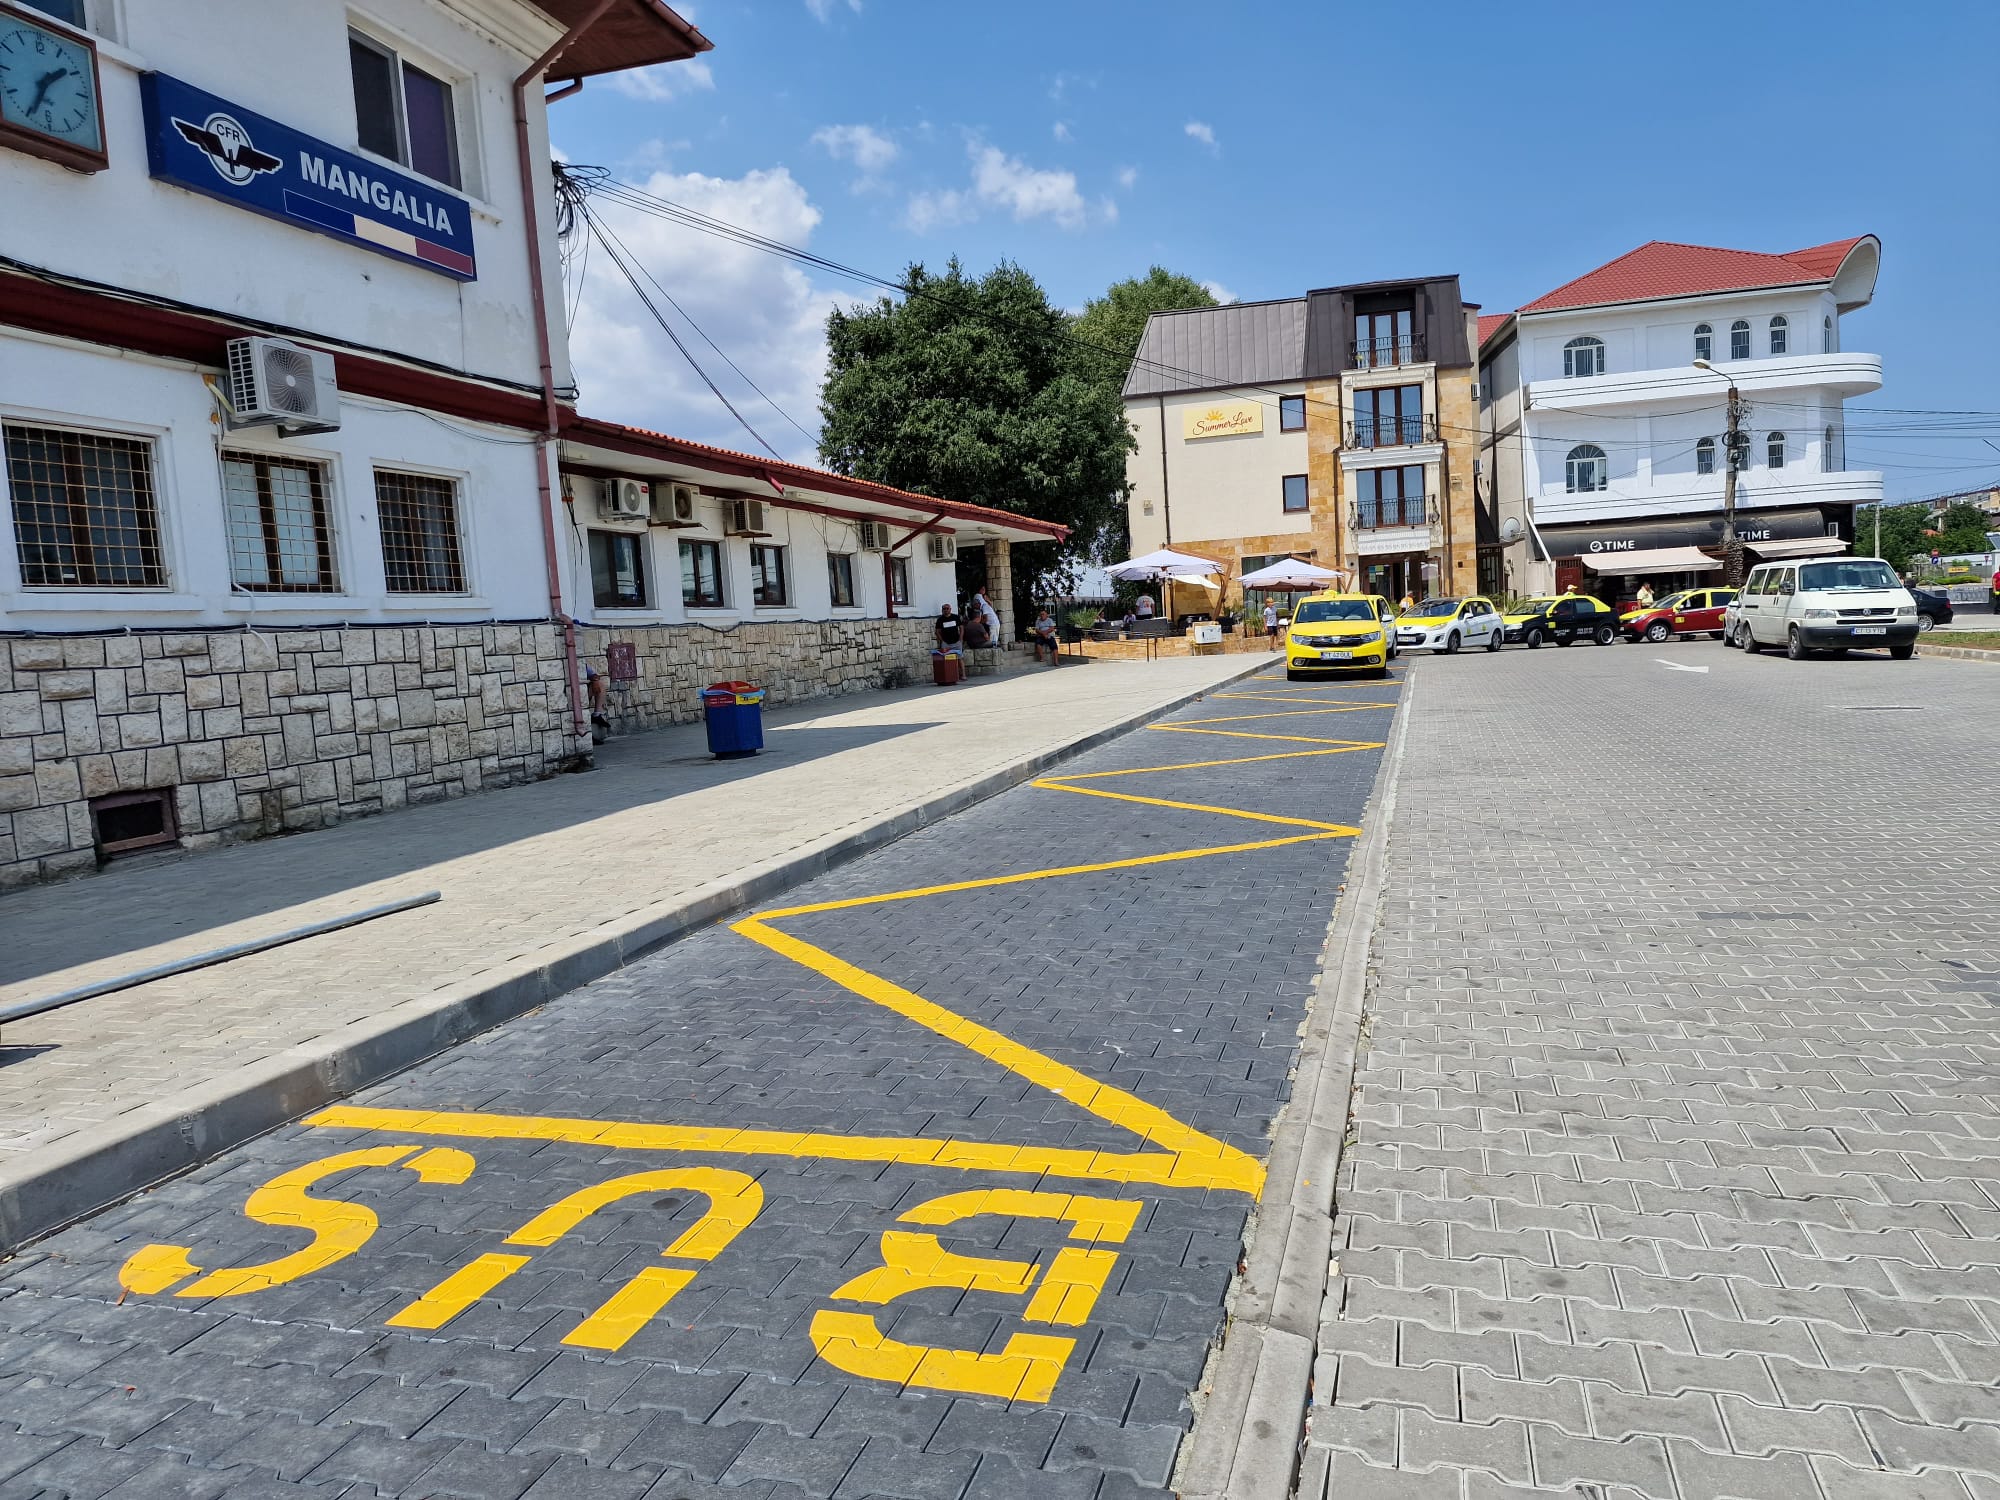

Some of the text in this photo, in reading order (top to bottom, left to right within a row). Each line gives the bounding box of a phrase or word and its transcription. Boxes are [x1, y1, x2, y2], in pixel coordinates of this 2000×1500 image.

[216, 124, 240, 143] CFR
[300, 151, 454, 236] MANGALIA
[118, 1145, 1144, 1404] BUS
